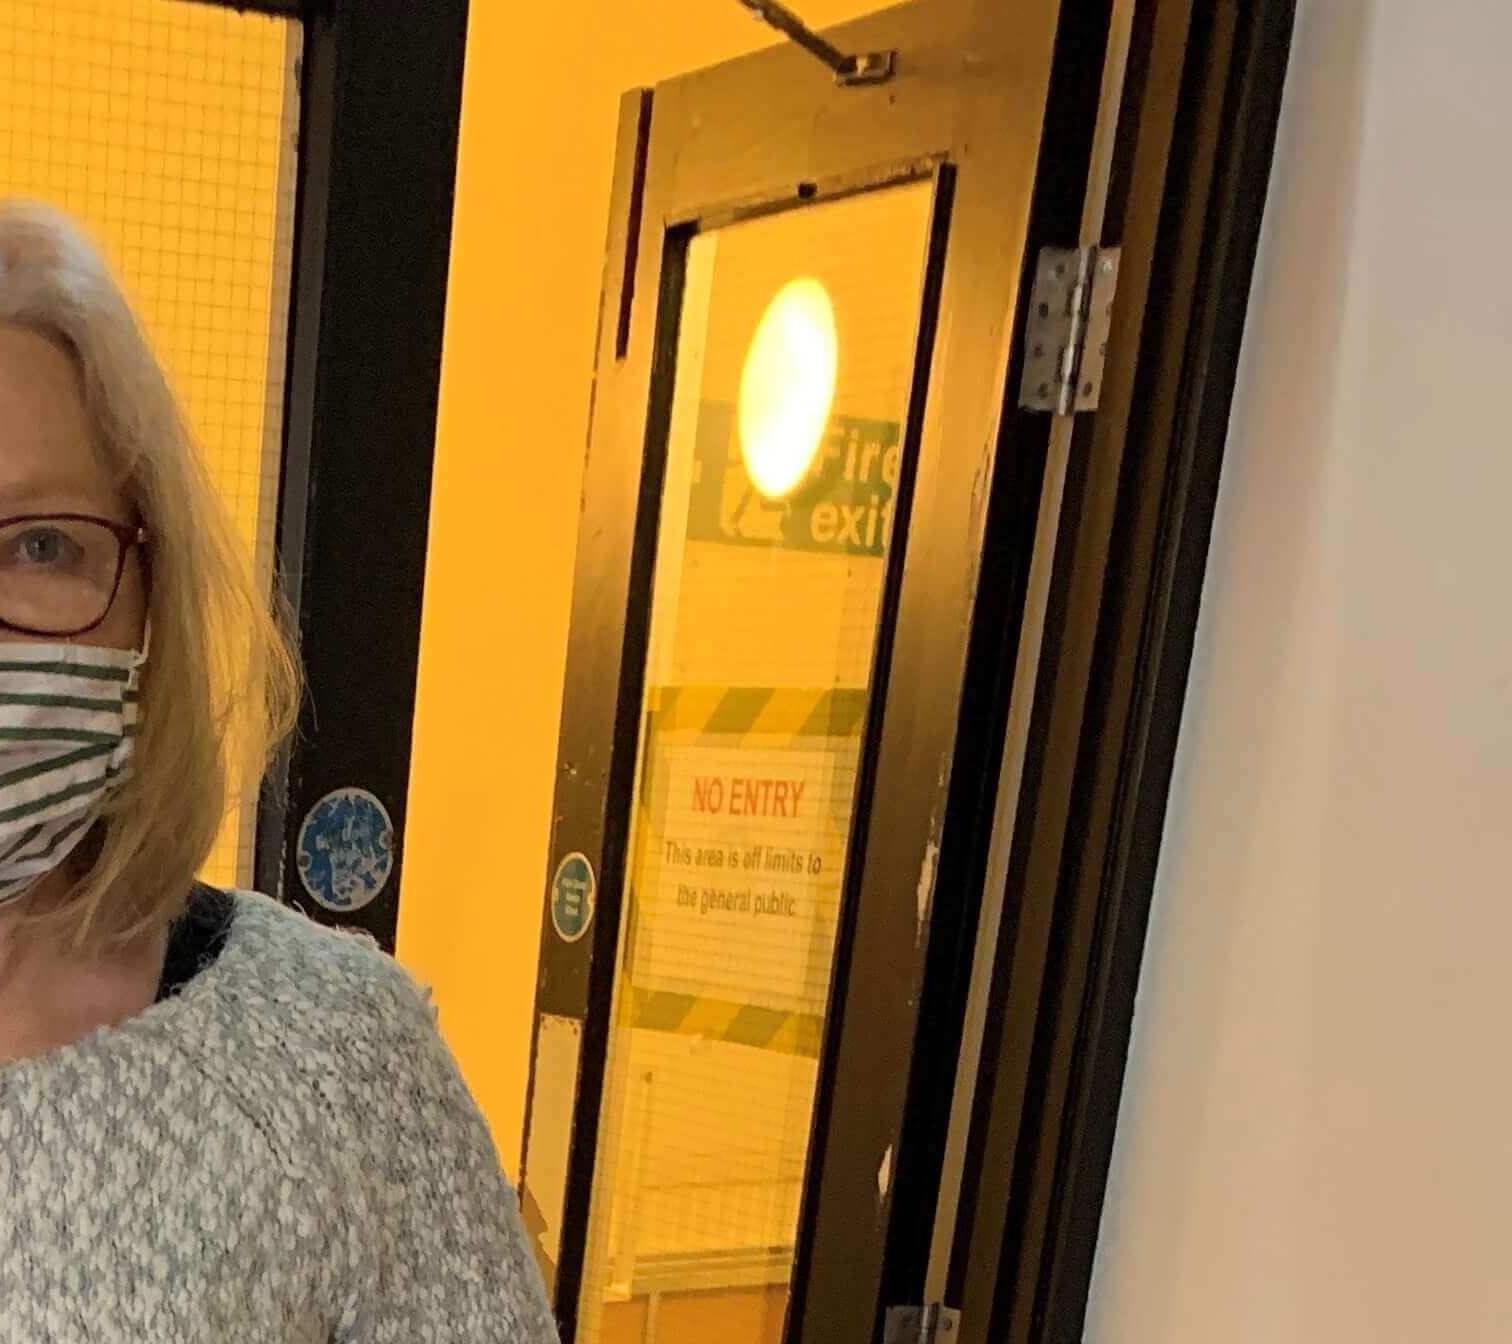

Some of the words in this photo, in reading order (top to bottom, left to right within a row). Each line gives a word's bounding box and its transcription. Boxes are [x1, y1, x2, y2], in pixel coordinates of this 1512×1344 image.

[693, 776, 724, 815] NO
[729, 778, 805, 818] ENTRY
[665, 841, 692, 865] This
[694, 848, 724, 868] area
[728, 848, 739, 869] is
[743, 846, 763, 870] off
[764, 846, 804, 874] limits
[807, 852, 822, 875] to
[676, 883, 698, 908] the
[699, 887, 751, 915] general
[753, 890, 797, 918] public
